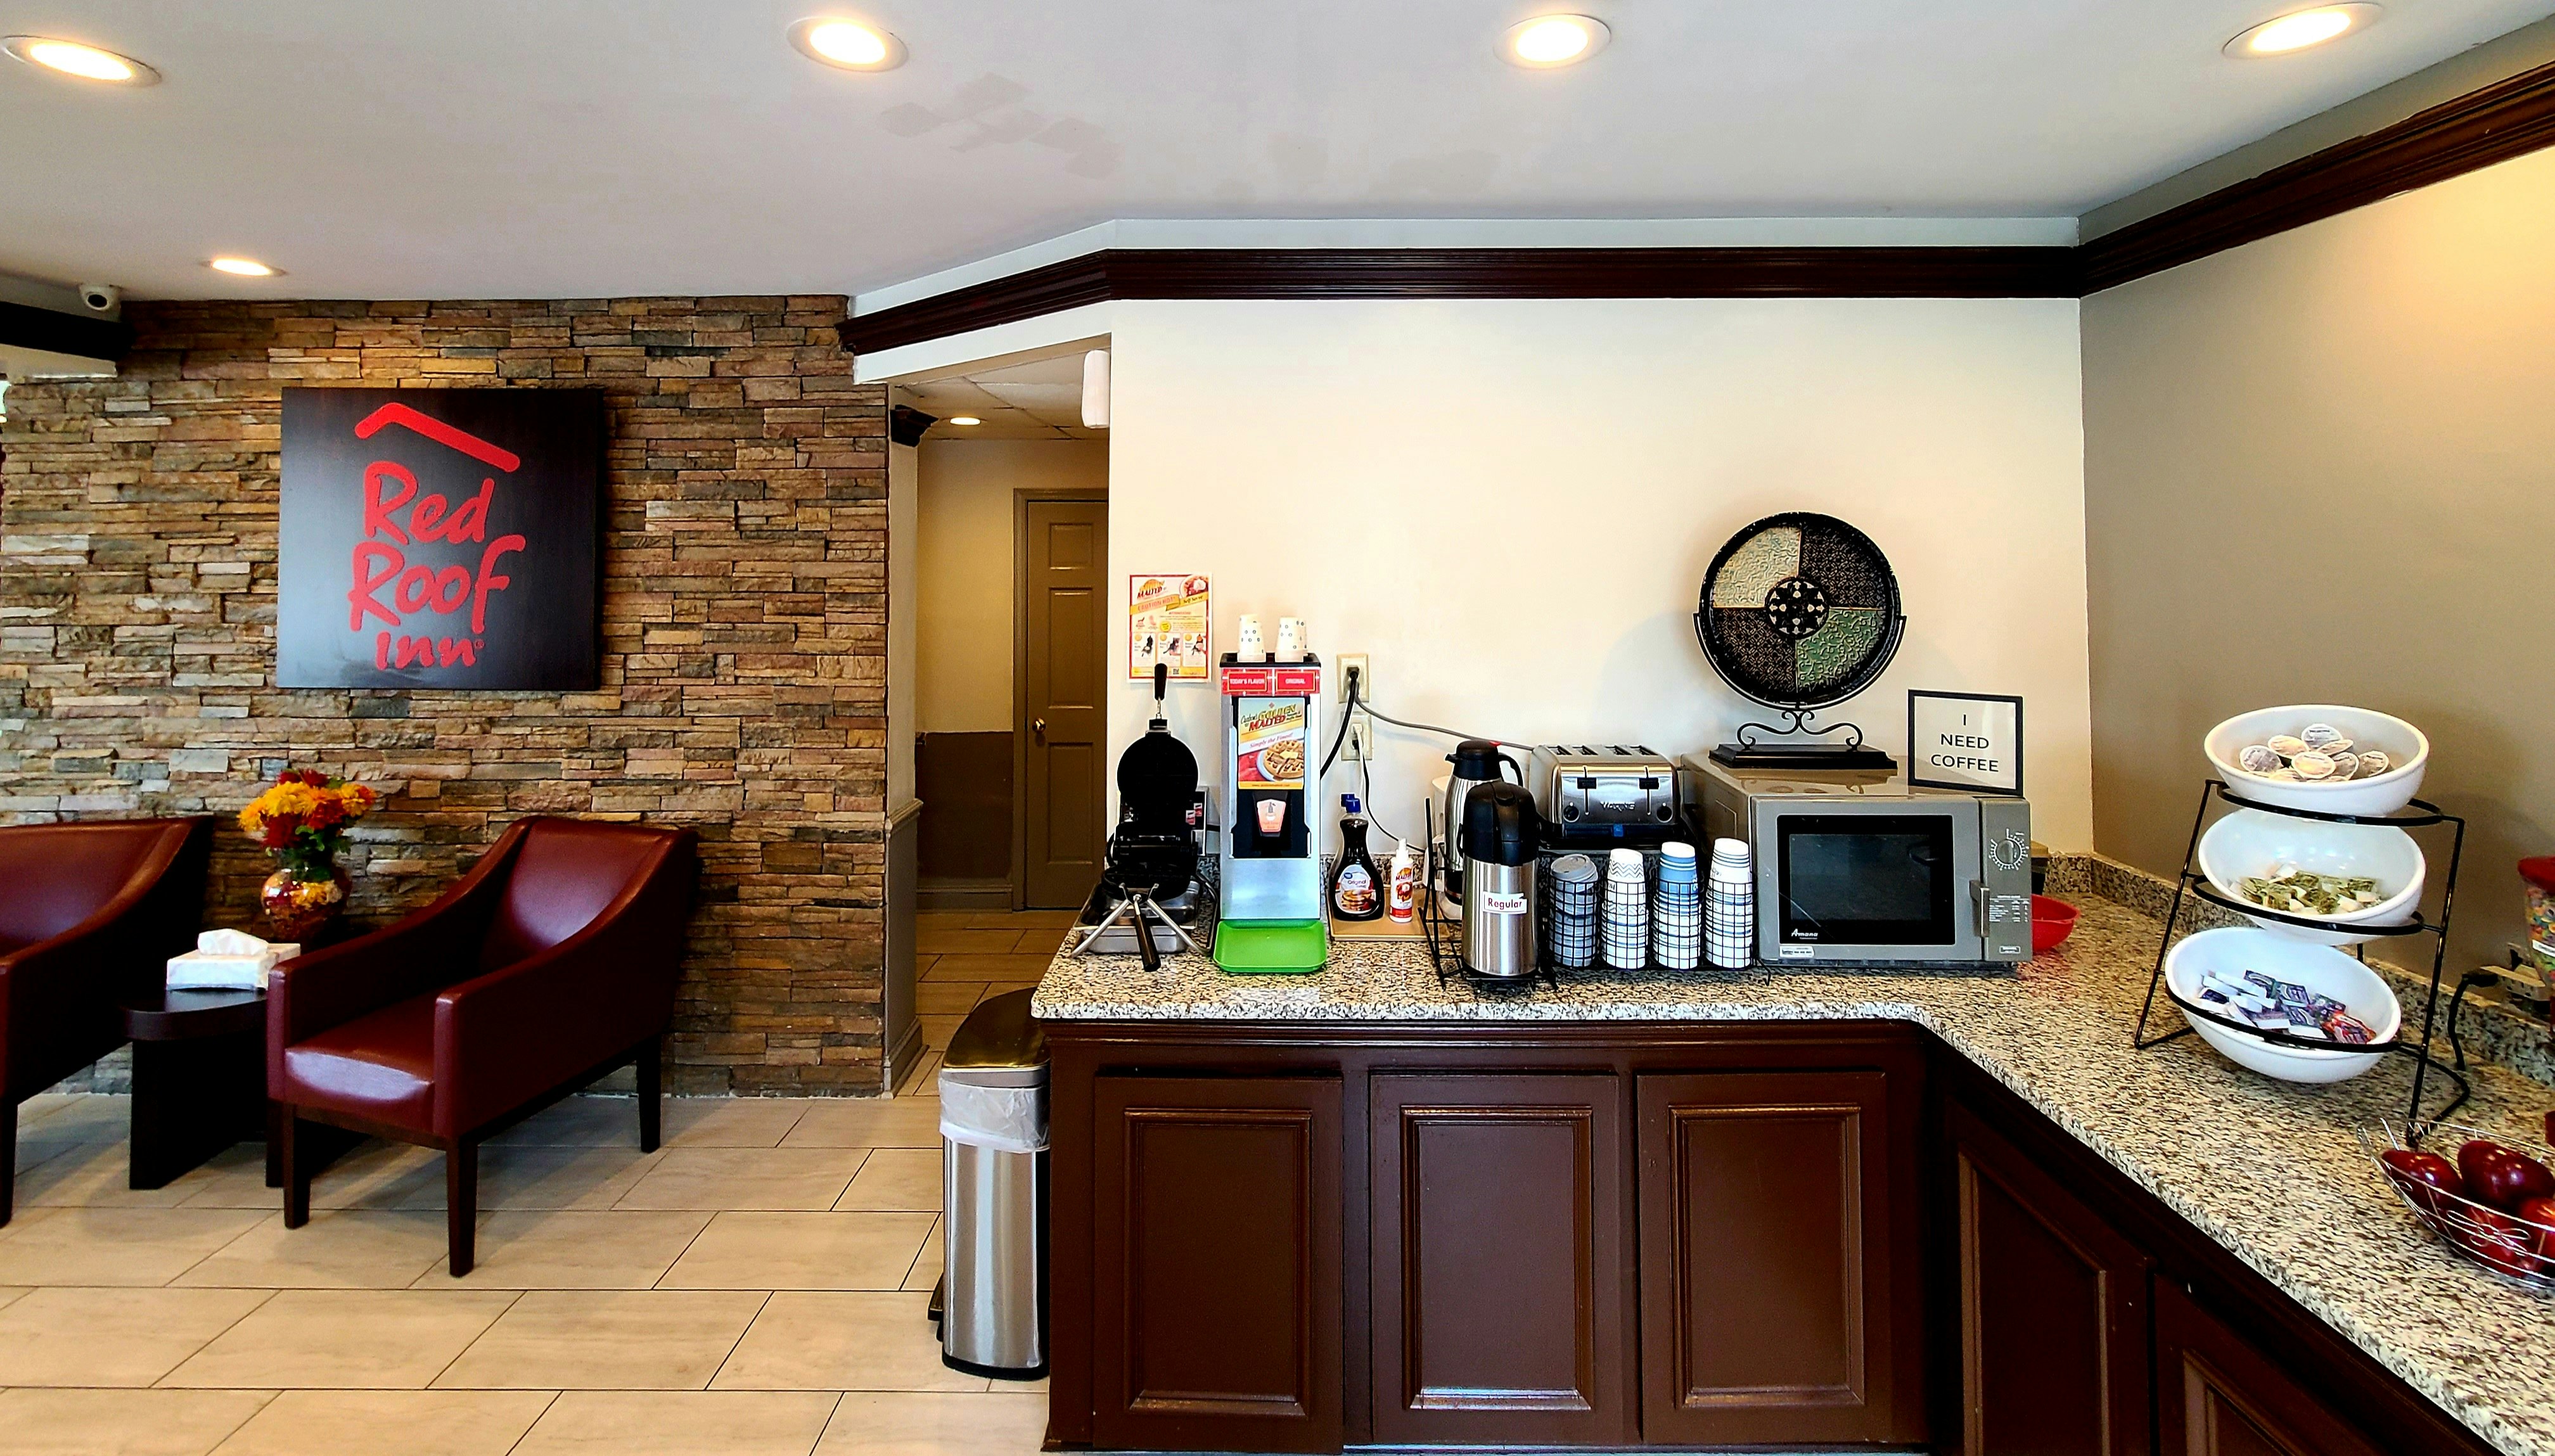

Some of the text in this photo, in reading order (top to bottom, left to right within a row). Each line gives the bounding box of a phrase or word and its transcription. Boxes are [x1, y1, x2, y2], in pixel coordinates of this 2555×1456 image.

[363, 461, 494, 544] Red
[347, 534, 526, 632] Roof
[1258, 704, 1296, 720] GOLDEN
[1963, 714, 1966, 725] I
[1249, 715, 1286, 731] MALTED
[1941, 734, 1989, 749] NEED
[1931, 755, 1999, 772] COFFEE
[1488, 898, 1522, 910] Regular
[1791, 928, 1819, 936] Amana
